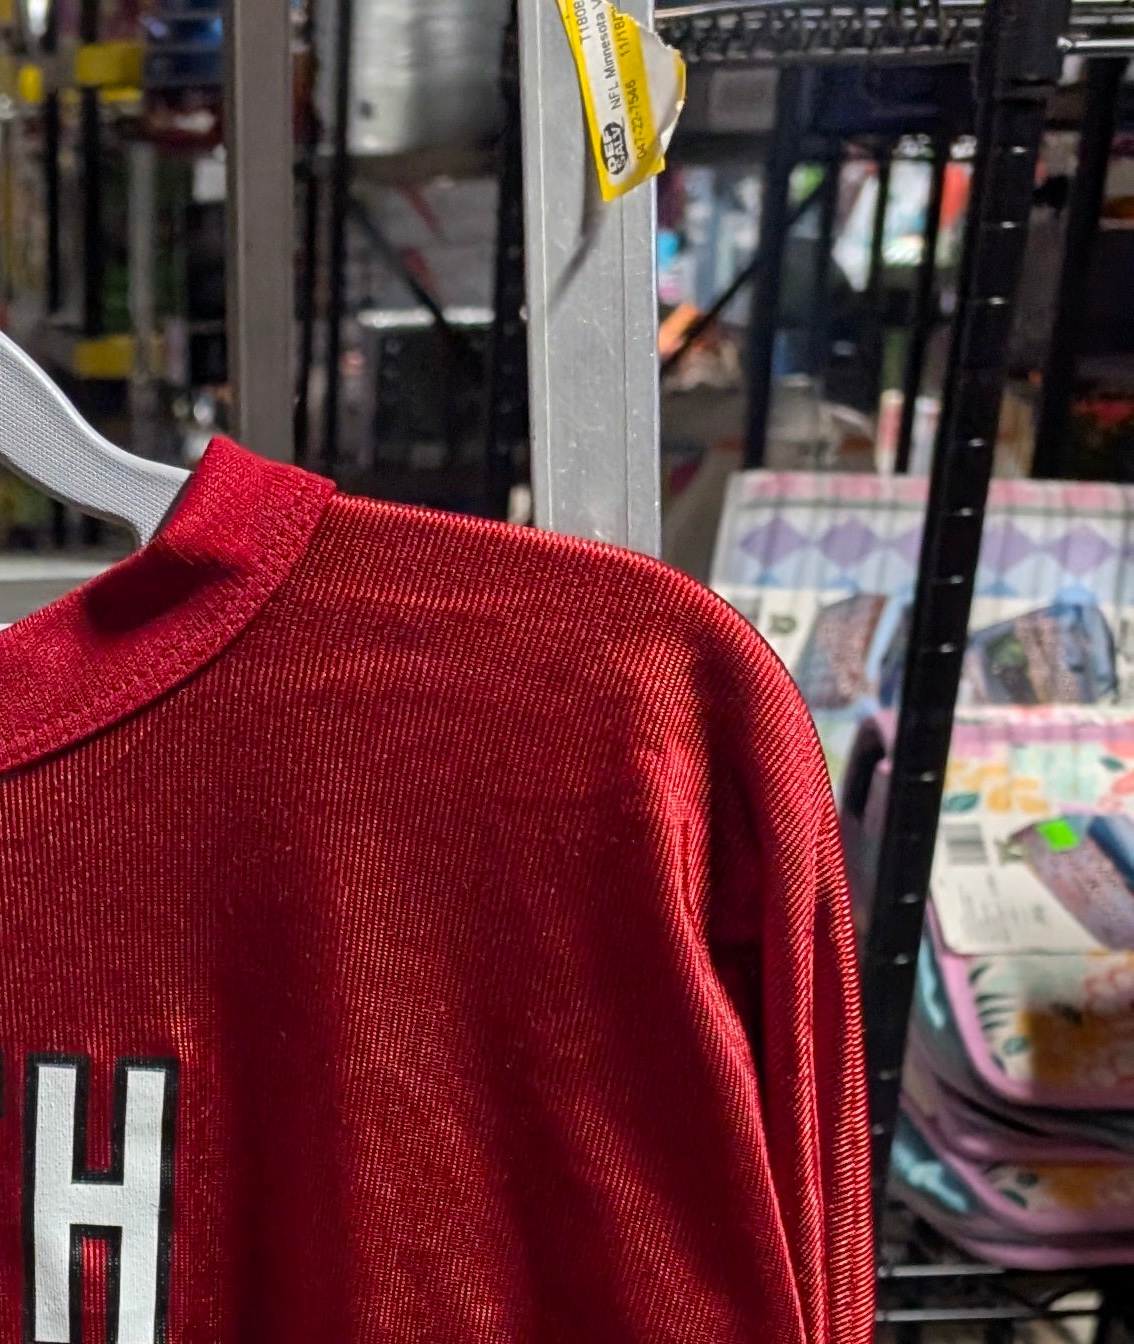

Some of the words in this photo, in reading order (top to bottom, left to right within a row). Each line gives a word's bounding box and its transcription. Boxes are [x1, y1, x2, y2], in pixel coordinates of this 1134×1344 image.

[596, 12, 616, 79] Minnesota
[608, 82, 621, 110] NFL
[604, 129, 617, 175] DEF
